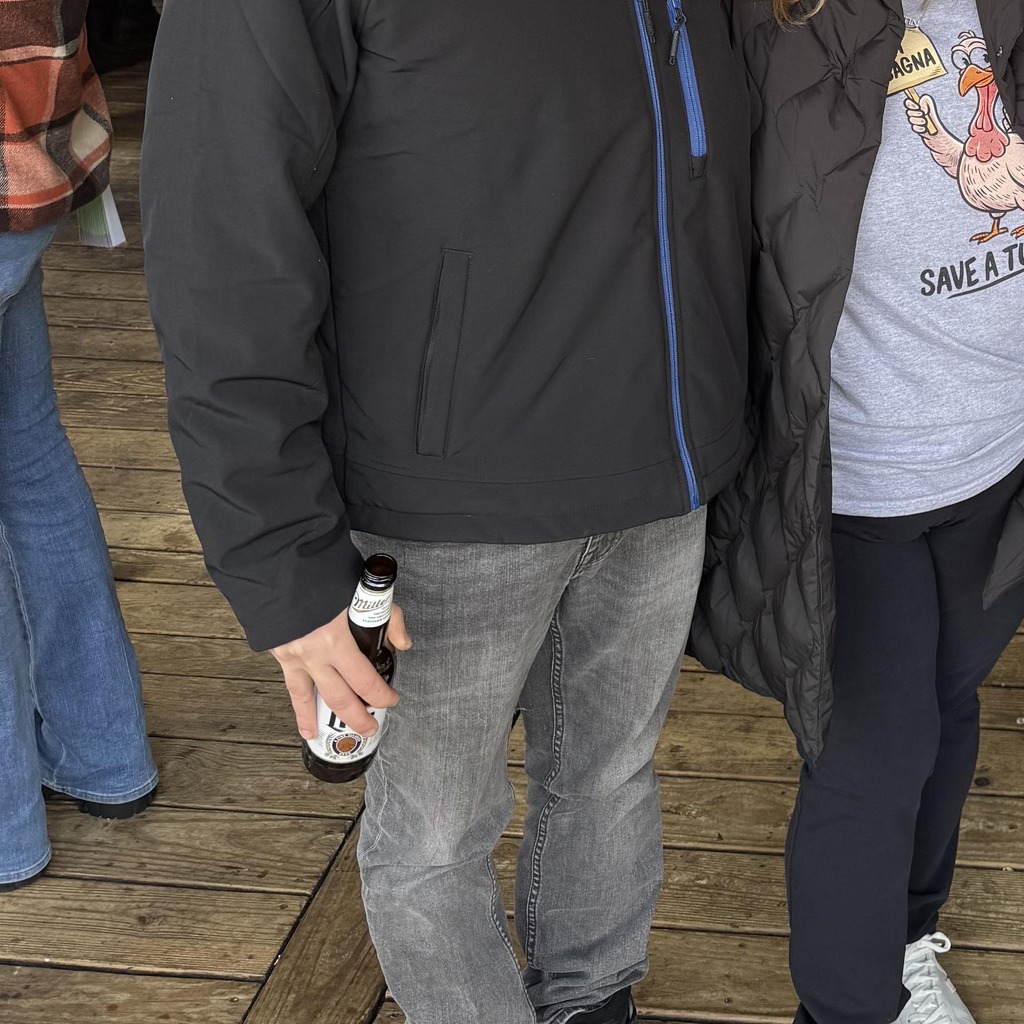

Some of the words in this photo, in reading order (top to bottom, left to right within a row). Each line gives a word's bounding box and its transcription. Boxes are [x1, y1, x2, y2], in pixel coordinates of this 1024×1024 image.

[888, 47, 937, 81] AGNA
[920, 255, 980, 297] SAVE
[985, 251, 999, 282] A
[352, 592, 392, 611] Miller
